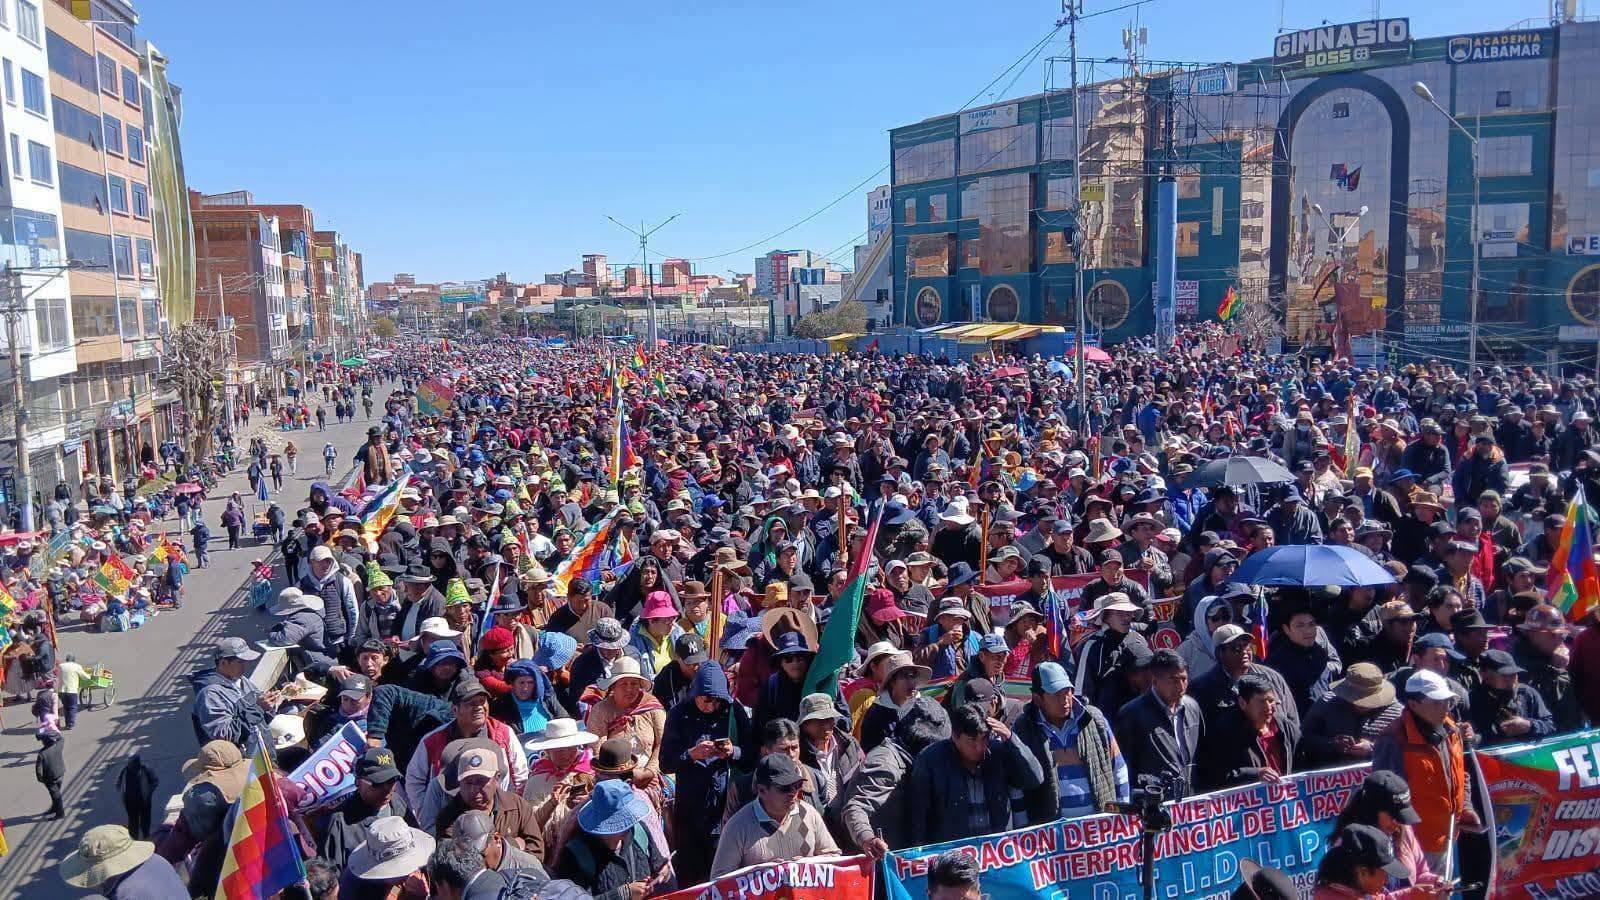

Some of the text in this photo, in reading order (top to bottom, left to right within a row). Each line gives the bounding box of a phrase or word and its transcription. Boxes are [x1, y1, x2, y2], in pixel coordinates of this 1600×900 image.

[1275, 20, 1408, 58] GIMNASIO
[1472, 43, 1541, 60] ALBAMAR
[1473, 33, 1541, 47] ACADEMIA
[1305, 50, 1352, 68] BOSS
[1241, 808, 1277, 839] DE
[1280, 798, 1311, 831] LA
[1311, 788, 1352, 822] PAZ
[894, 827, 1058, 882] FERACION
[735, 862, 835, 900] PUCARANI
